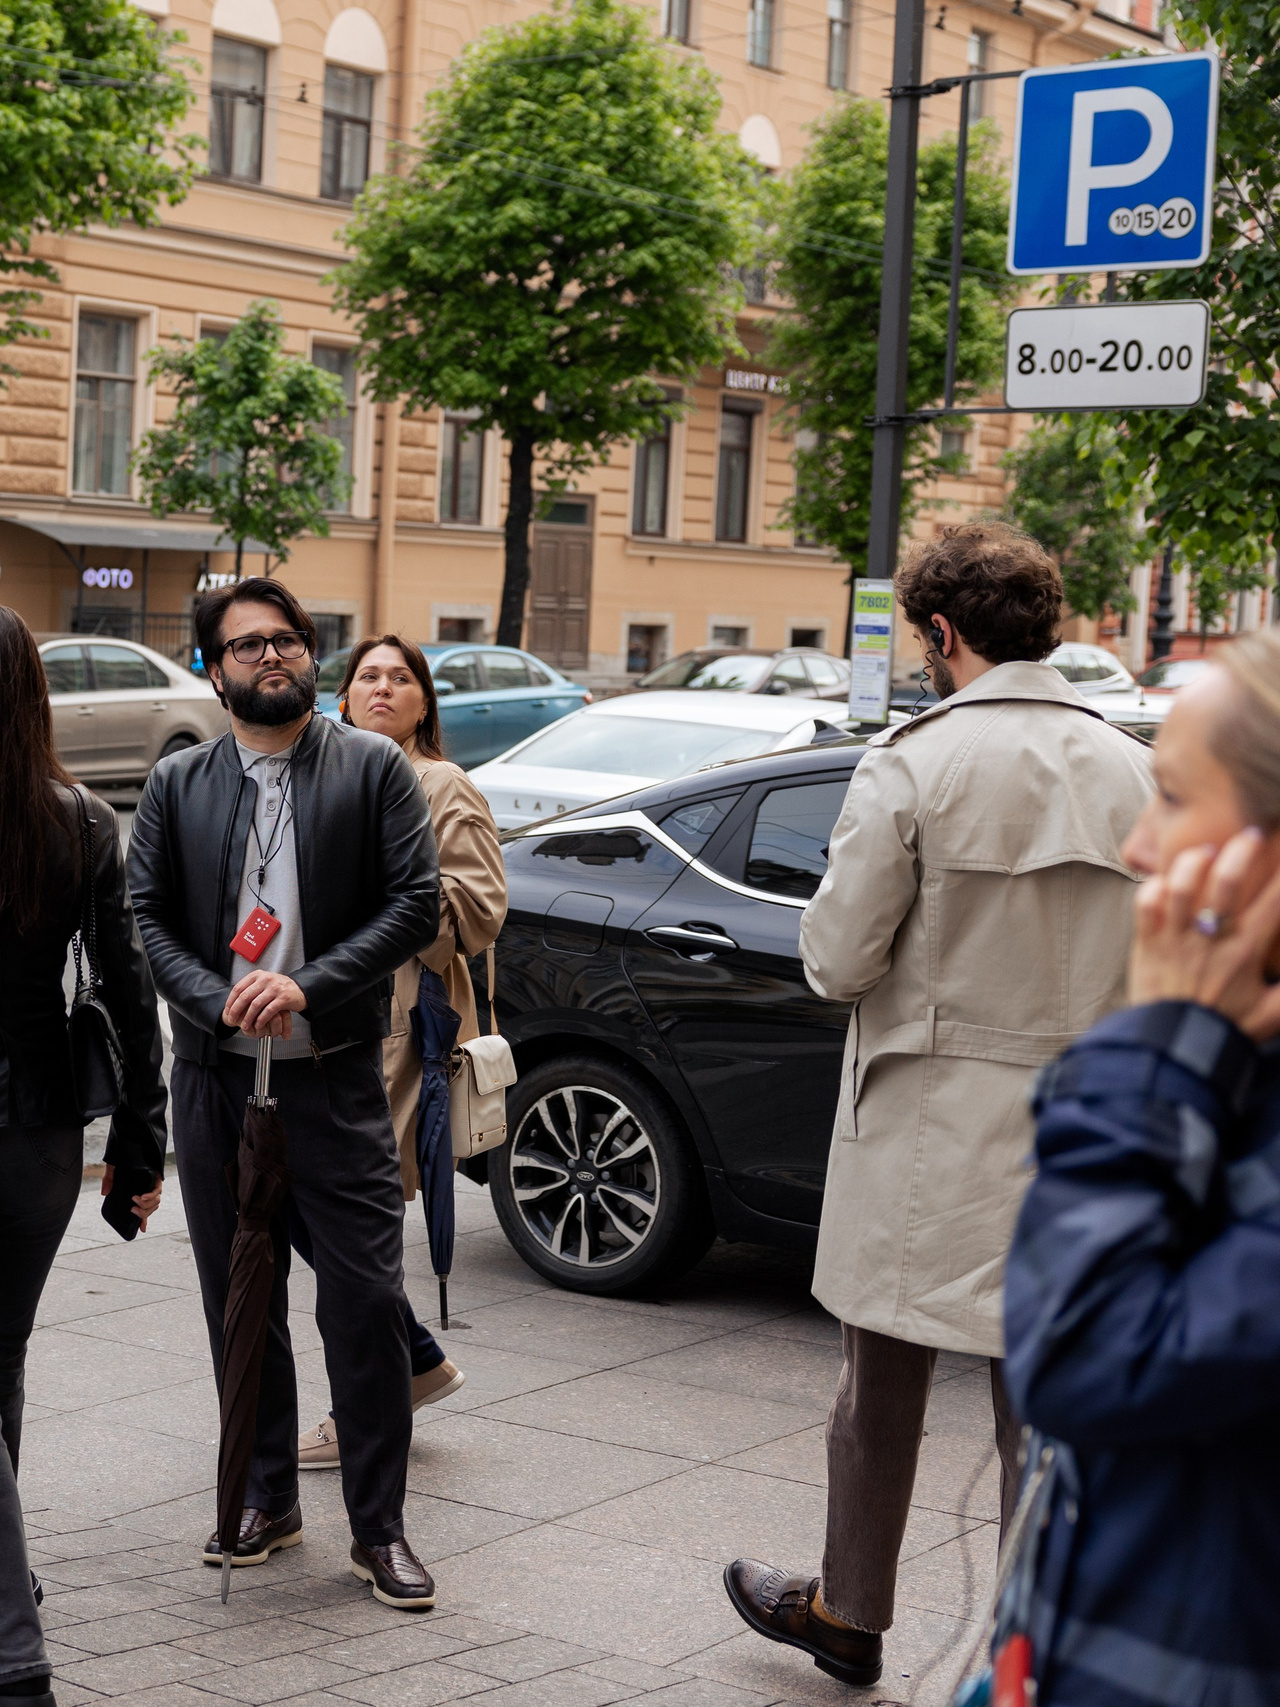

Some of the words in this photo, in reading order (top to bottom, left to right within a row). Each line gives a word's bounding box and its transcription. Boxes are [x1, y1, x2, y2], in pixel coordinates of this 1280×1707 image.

[1065, 86, 1174, 246] P
[1115, 214, 1130, 228] 10
[1136, 210, 1154, 229] 15
[1162, 207, 1192, 230] 20
[1017, 339, 1193, 376] 8.00-20.00
[82, 567, 134, 589] ФОТО
[514, 799, 566, 813] LAD
